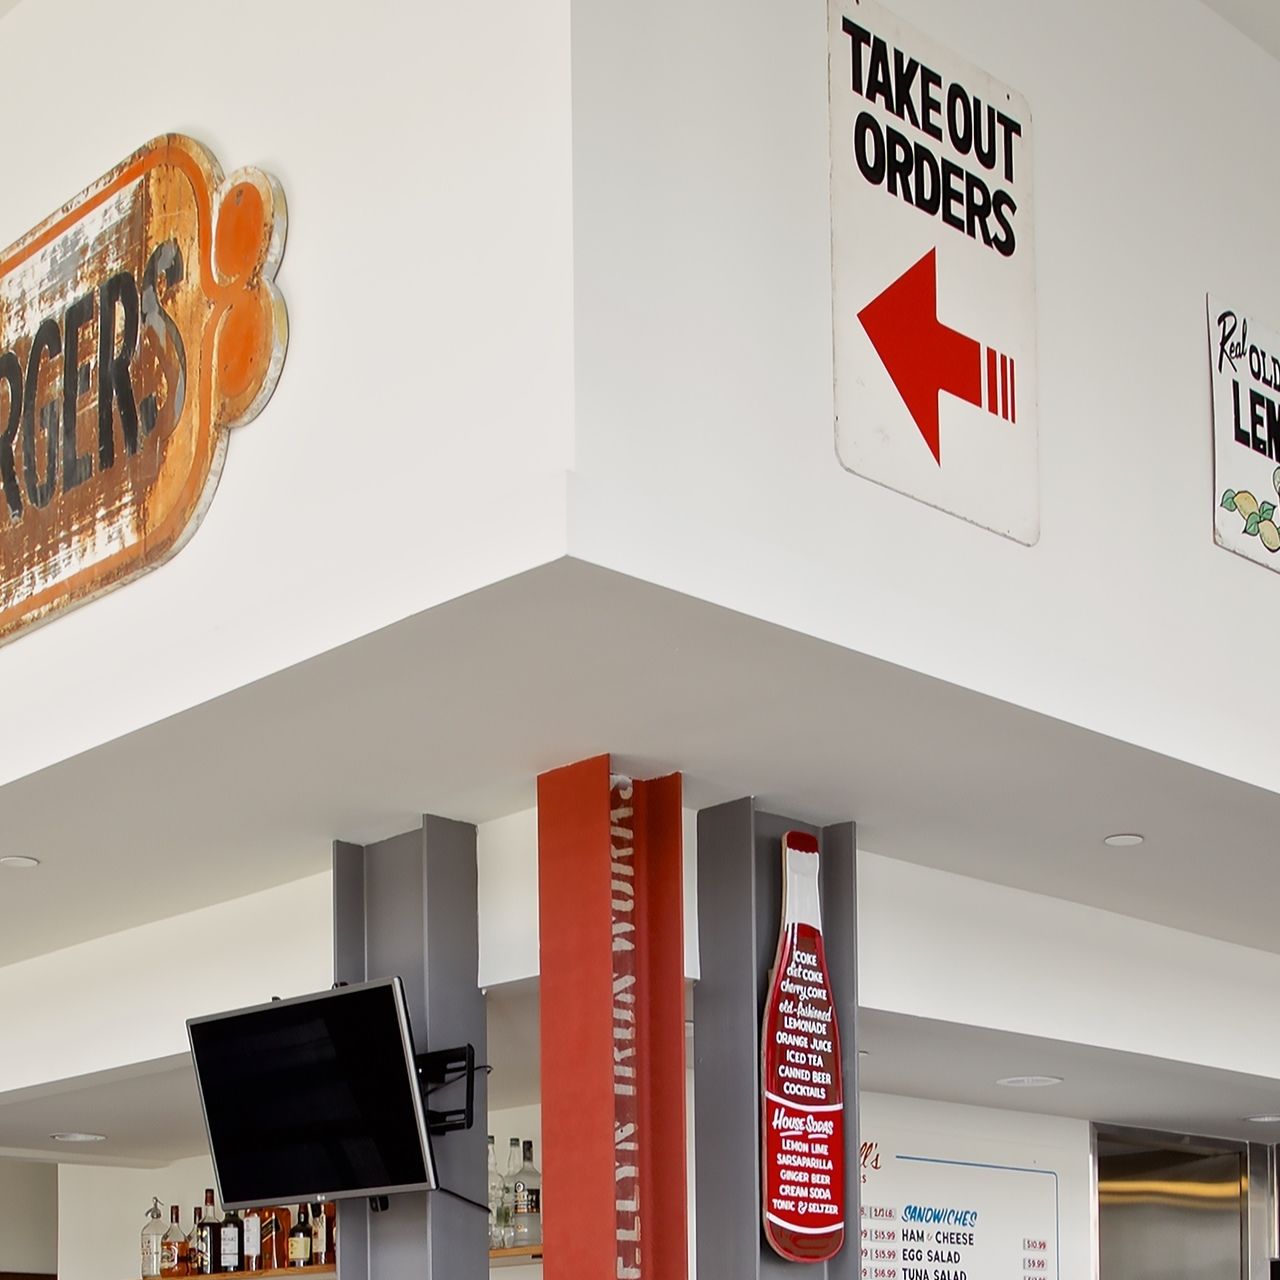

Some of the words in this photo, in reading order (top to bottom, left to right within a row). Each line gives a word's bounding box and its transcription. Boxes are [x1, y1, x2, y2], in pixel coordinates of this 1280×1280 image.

[842, 15, 942, 143] TAKE
[947, 82, 1022, 183] OUT
[854, 111, 1017, 257] ORDERS
[1217, 310, 1247, 373] Real
[1249, 344, 1280, 392] OLD
[795, 951, 817, 966] COKE
[803, 969, 823, 983] COKE
[781, 979, 808, 1000] cherry
[808, 987, 827, 1000] COKE
[784, 1016, 826, 1035] LEMONADE
[776, 1032, 808, 1048] ORANGE
[810, 1039, 832, 1052] JUICE
[786, 1050, 806, 1064] ICED
[807, 1055, 823, 1067] TEA
[779, 1065, 810, 1081] CANNED
[812, 1071, 831, 1084] BEER
[783, 1082, 826, 1099] COCKTAILS
[782, 1139, 808, 1152] LEMON
[811, 1143, 828, 1155] LIME
[777, 1153, 833, 1170] SARSAPARILLA
[780, 1170, 809, 1182] GINGER
[811, 1173, 830, 1185] BEER
[779, 1184, 808, 1198] CREAM
[809, 1187, 831, 1200] SODA
[773, 1199, 795, 1211] TONIC
[902, 1205, 977, 1227] SANDWICHES
[902, 1229, 924, 1242] HAM
[935, 1231, 974, 1245] CHEESE
[903, 1249, 922, 1261] EGG
[927, 1250, 960, 1263] SALAD
[902, 1268, 929, 1280] TUNA
